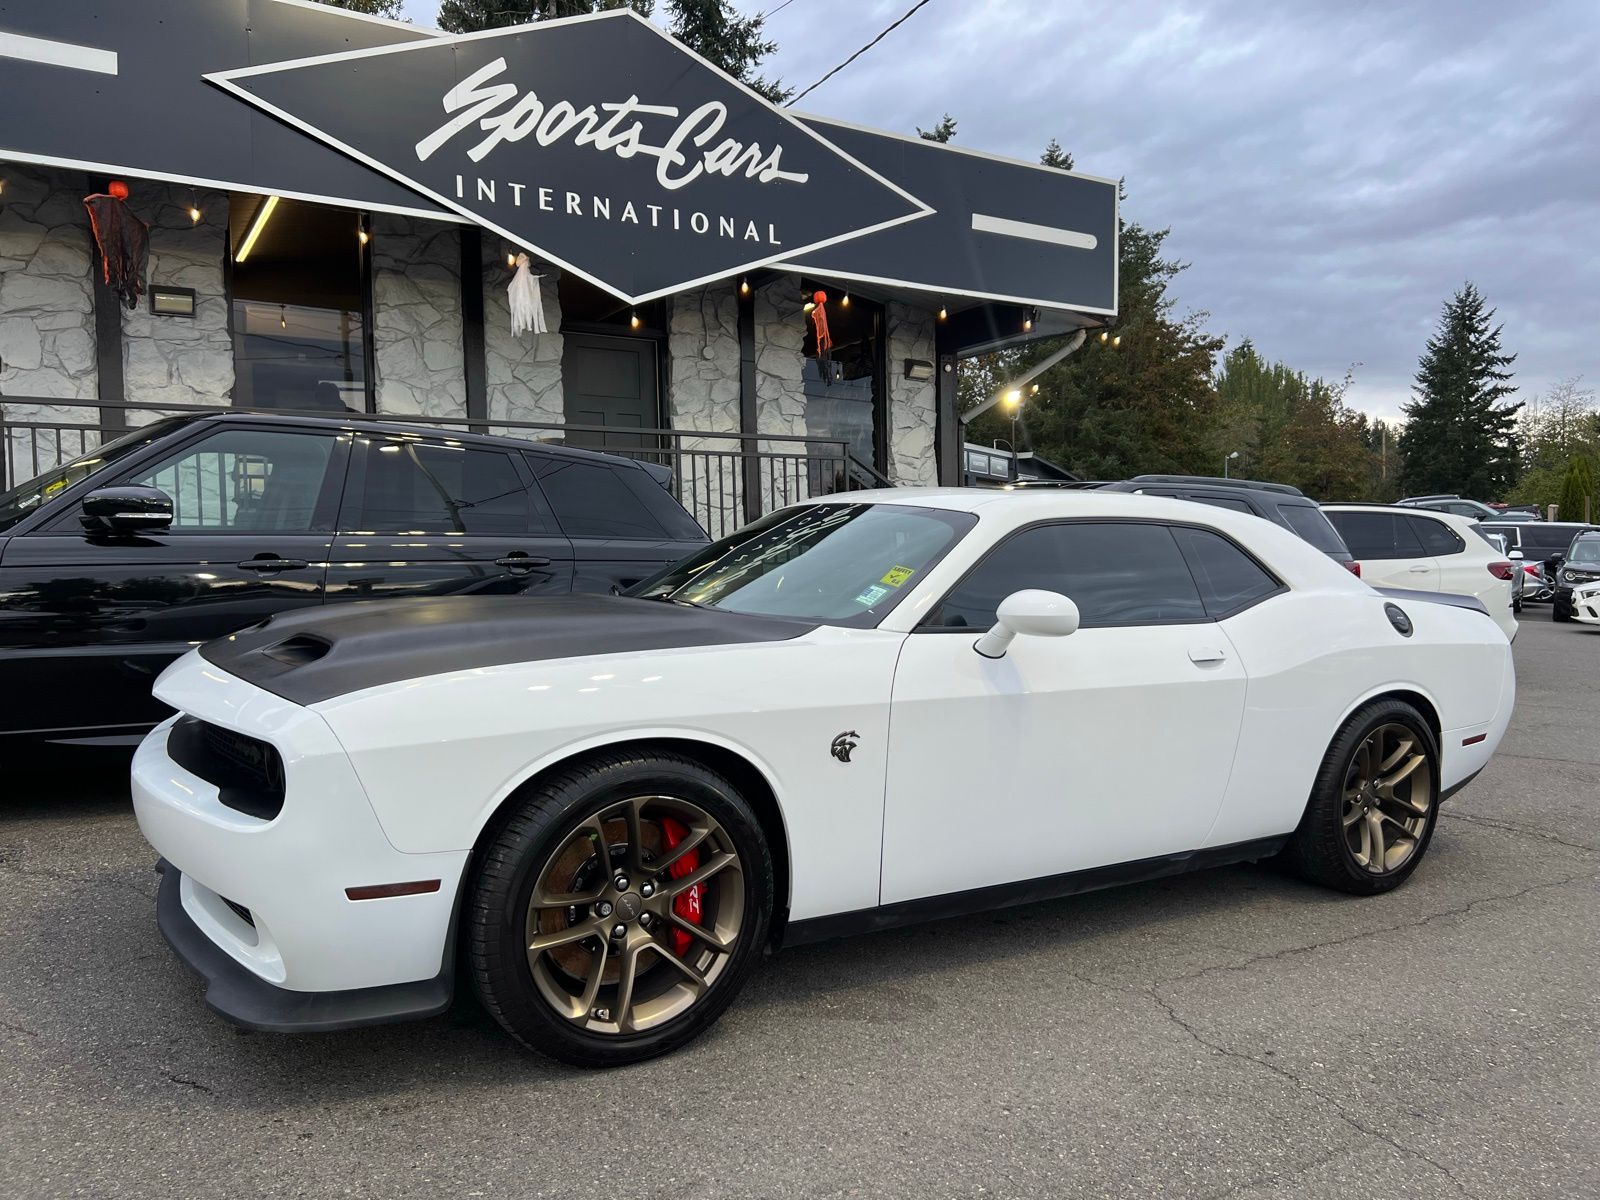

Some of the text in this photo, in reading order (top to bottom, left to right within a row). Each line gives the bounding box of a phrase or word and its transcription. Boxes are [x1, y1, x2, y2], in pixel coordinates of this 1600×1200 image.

[415, 56, 809, 190] Sports Cars
[456, 174, 782, 245] INTERNATIONAL
